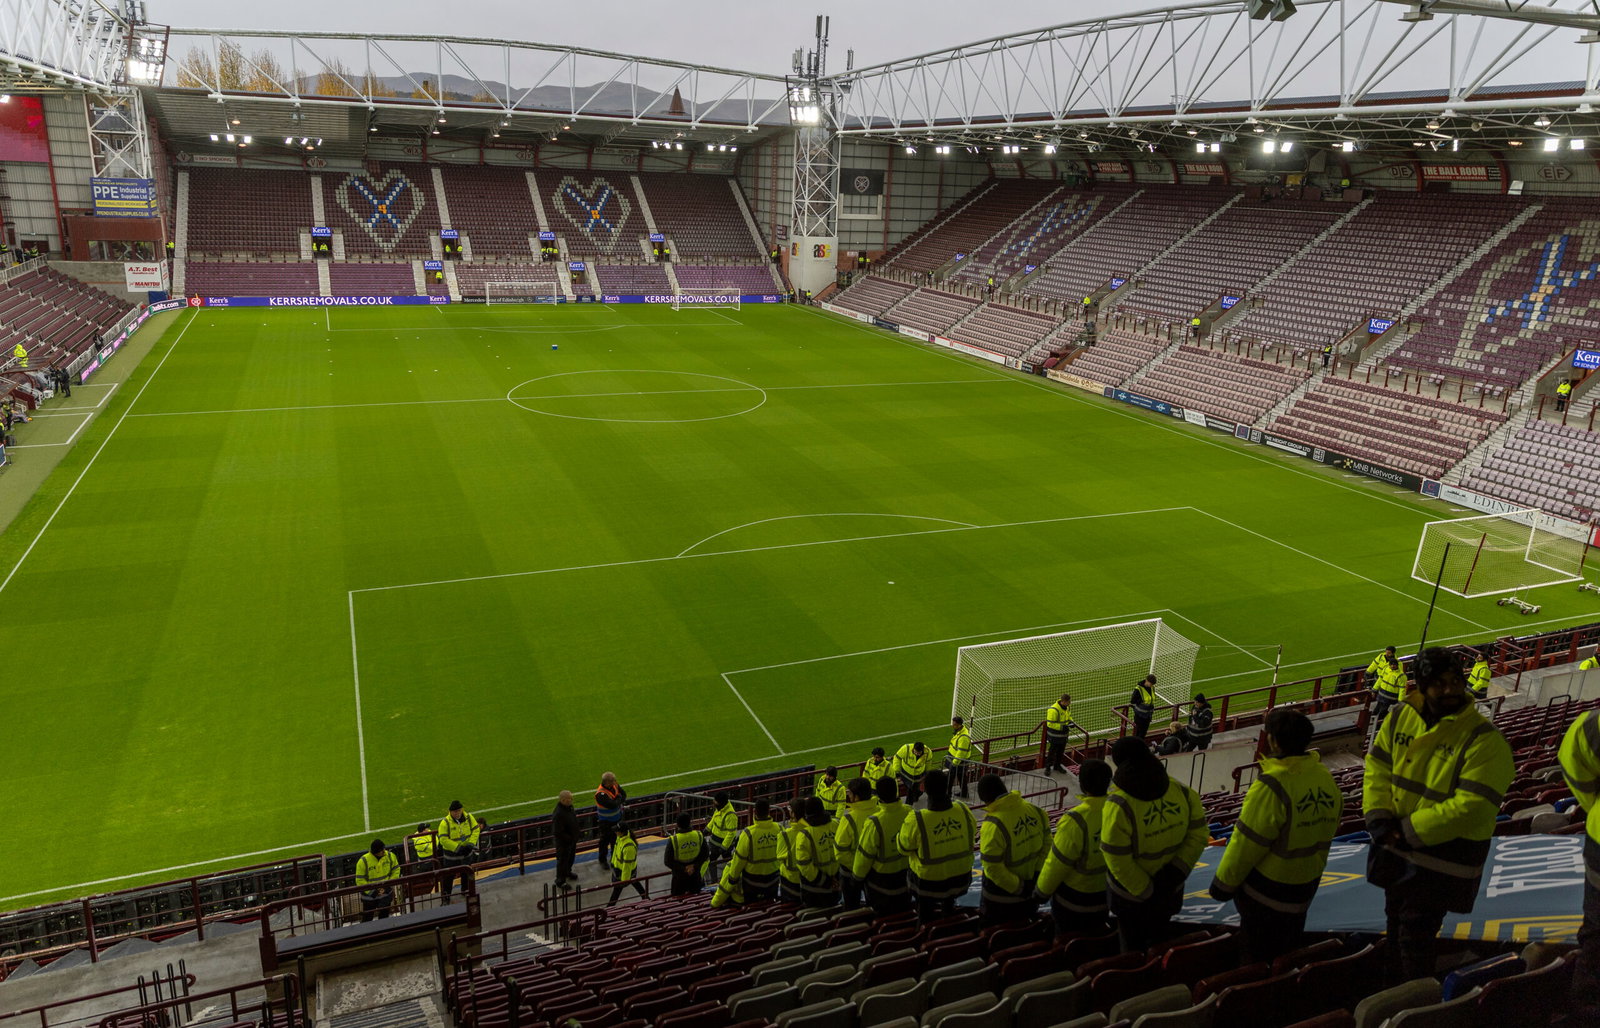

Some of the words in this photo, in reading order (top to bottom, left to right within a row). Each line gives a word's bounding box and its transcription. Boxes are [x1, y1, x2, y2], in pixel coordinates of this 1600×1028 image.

[1422, 166, 1438, 175] THE
[1439, 167, 1459, 176] BALL
[1460, 166, 1486, 176] ROOM
[93, 186, 119, 198] PPE
[269, 296, 393, 305] KERRSREMOVALS.CO.UK
[644, 295, 740, 303] KERRSREMOVALS.CO.UK
[1287, 440, 1302, 449] GROUP
[1353, 462, 1368, 473] MNB
[1370, 465, 1403, 483] Networks
